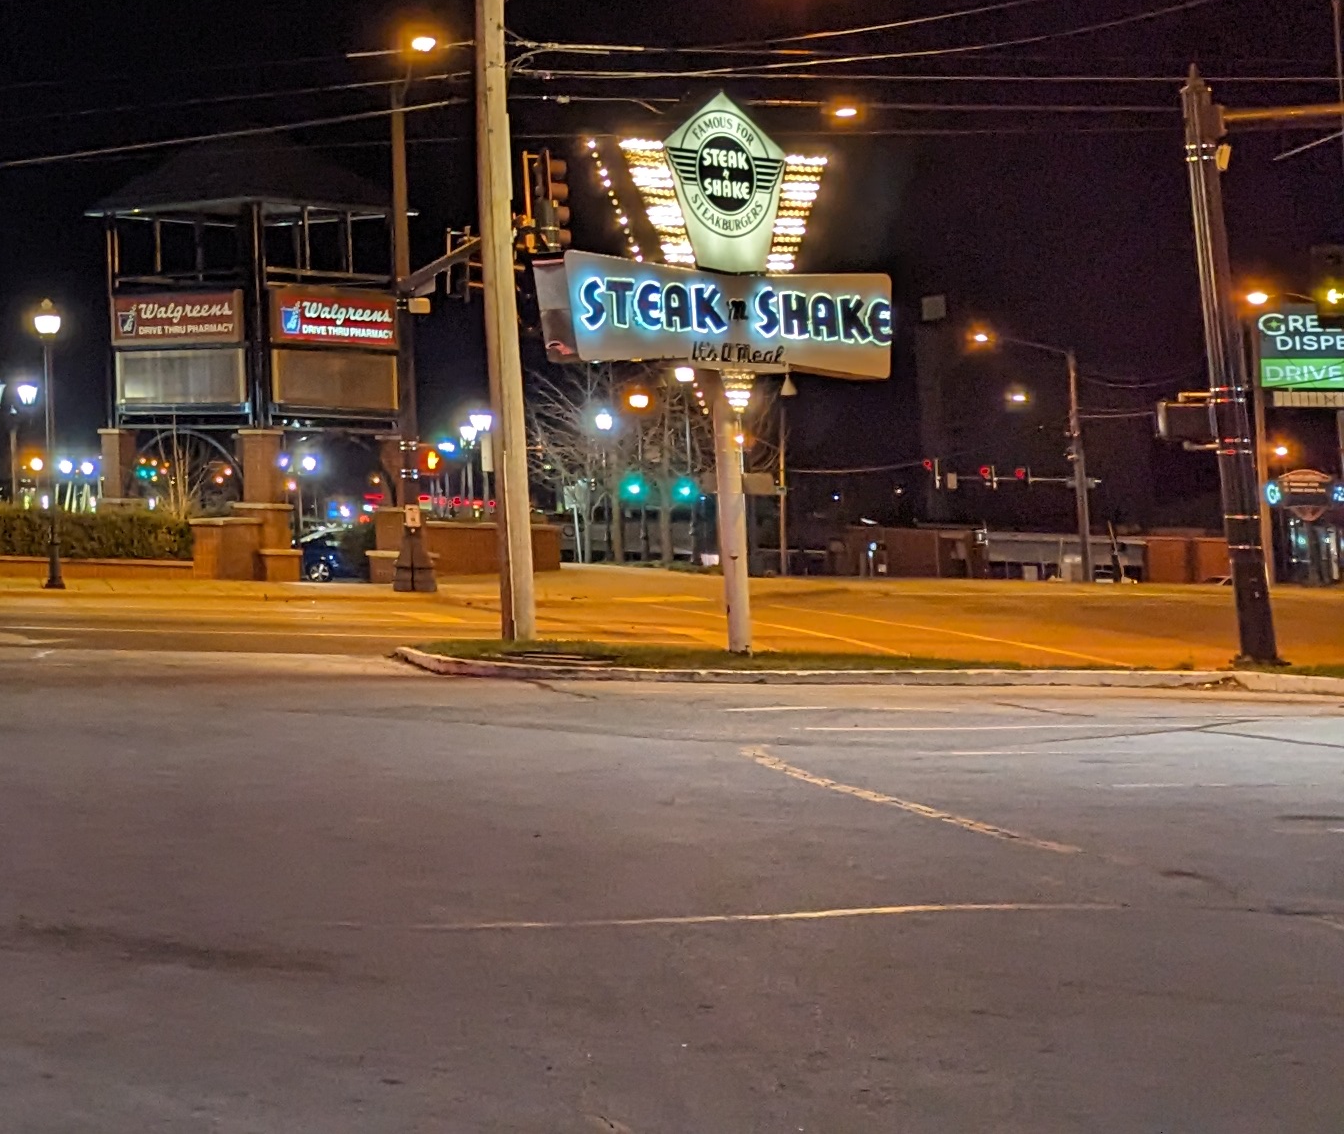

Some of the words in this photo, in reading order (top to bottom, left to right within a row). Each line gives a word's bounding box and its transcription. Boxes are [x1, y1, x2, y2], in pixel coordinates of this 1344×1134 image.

[692, 117, 733, 140] FAMOUS
[736, 123, 754, 147] FOR
[703, 148, 749, 170] STEAK
[703, 178, 750, 199] SHAKE
[692, 193, 763, 231] STEAKBURGERS
[139, 302, 232, 323] Walgreens
[302, 301, 393, 325] Walgreens
[580, 276, 728, 334] STEAK
[754, 286, 892, 346] SHAKE
[139, 326, 162, 335] DRIVE
[164, 325, 186, 334] THRU
[187, 323, 233, 334] PHARMACY
[302, 325, 327, 335] DRIVE
[328, 327, 349, 337] THRU
[350, 328, 393, 339] PHARMACY
[1258, 313, 1343, 335] GRE
[1265, 365, 1344, 381] DRIVE
